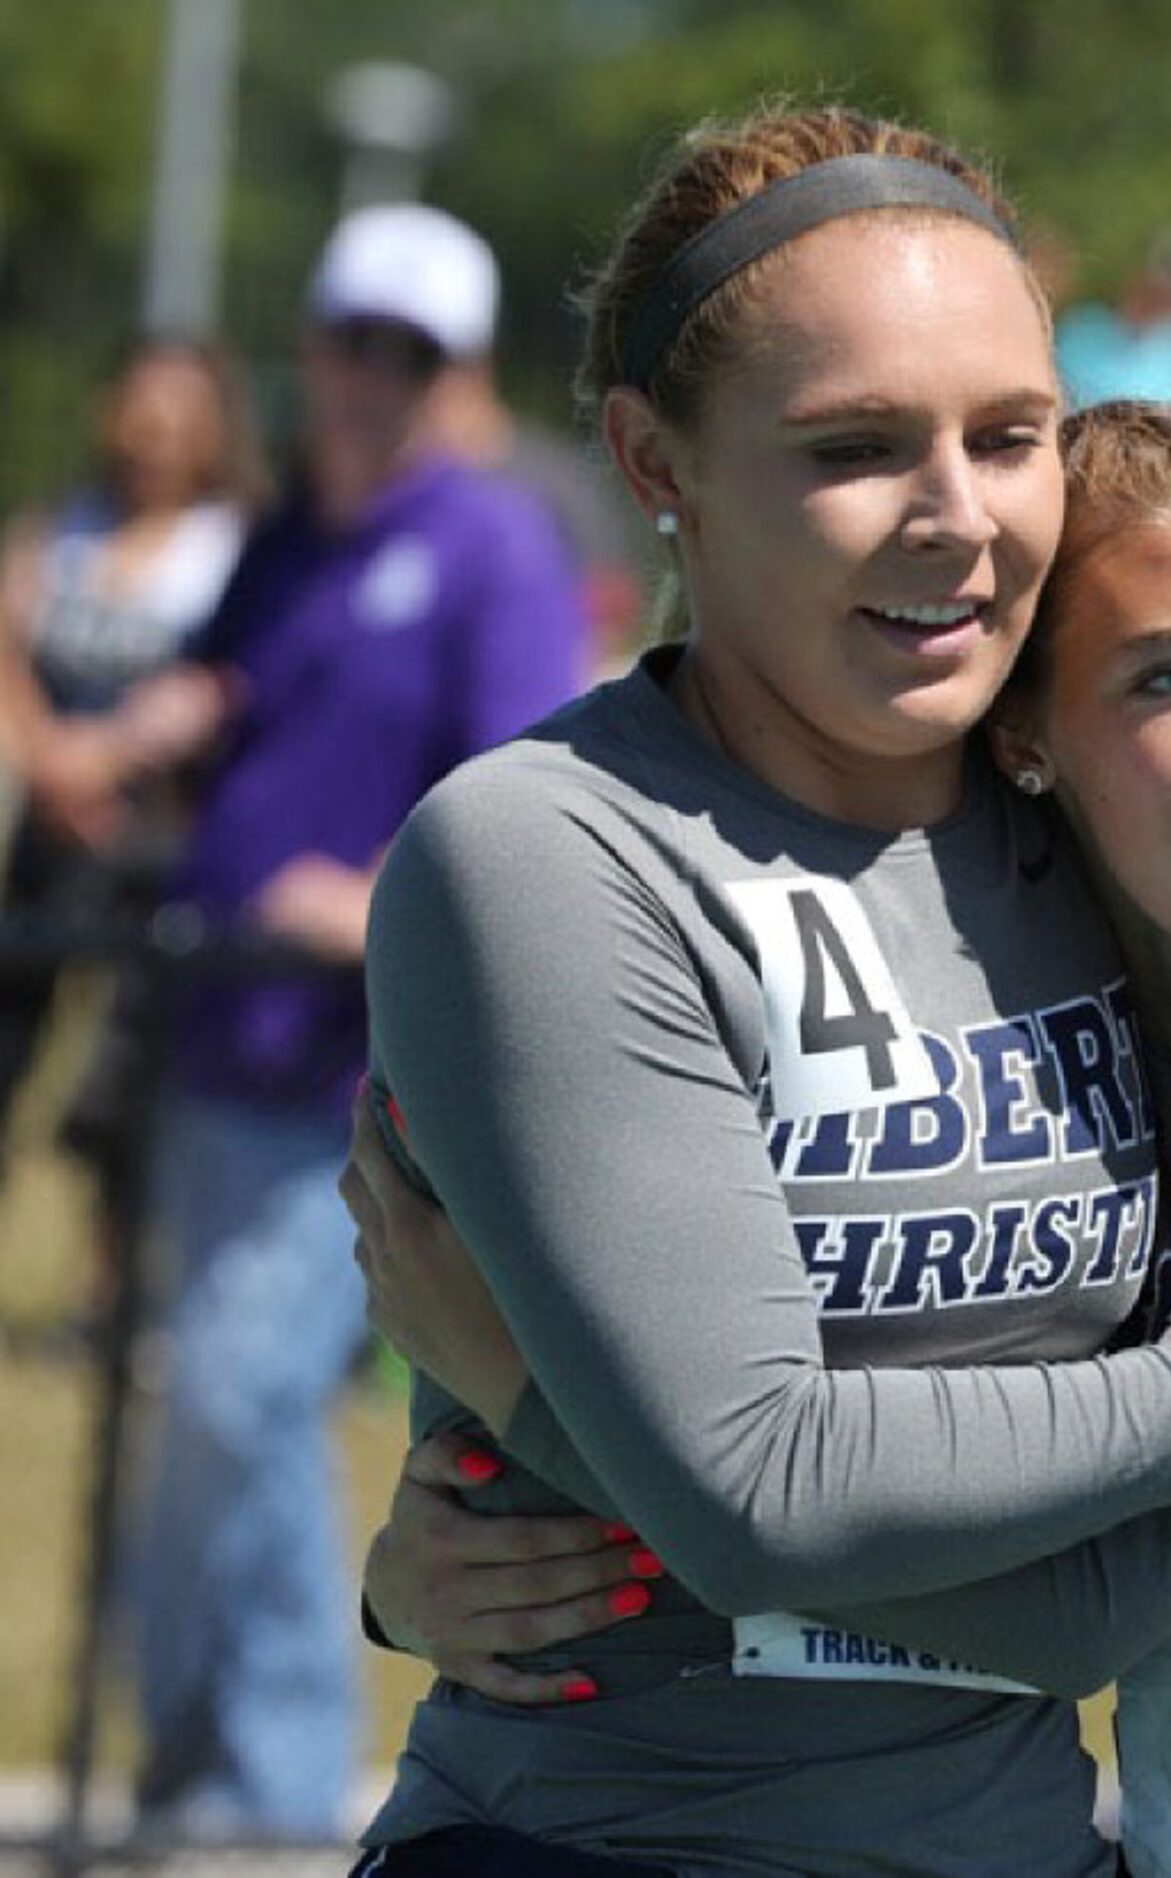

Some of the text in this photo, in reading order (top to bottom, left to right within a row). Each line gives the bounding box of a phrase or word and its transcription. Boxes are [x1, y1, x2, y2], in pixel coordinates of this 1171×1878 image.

[767, 977, 1156, 1182] IBER
[787, 889, 899, 1093] 4
[801, 1627, 910, 1668] TRACK
